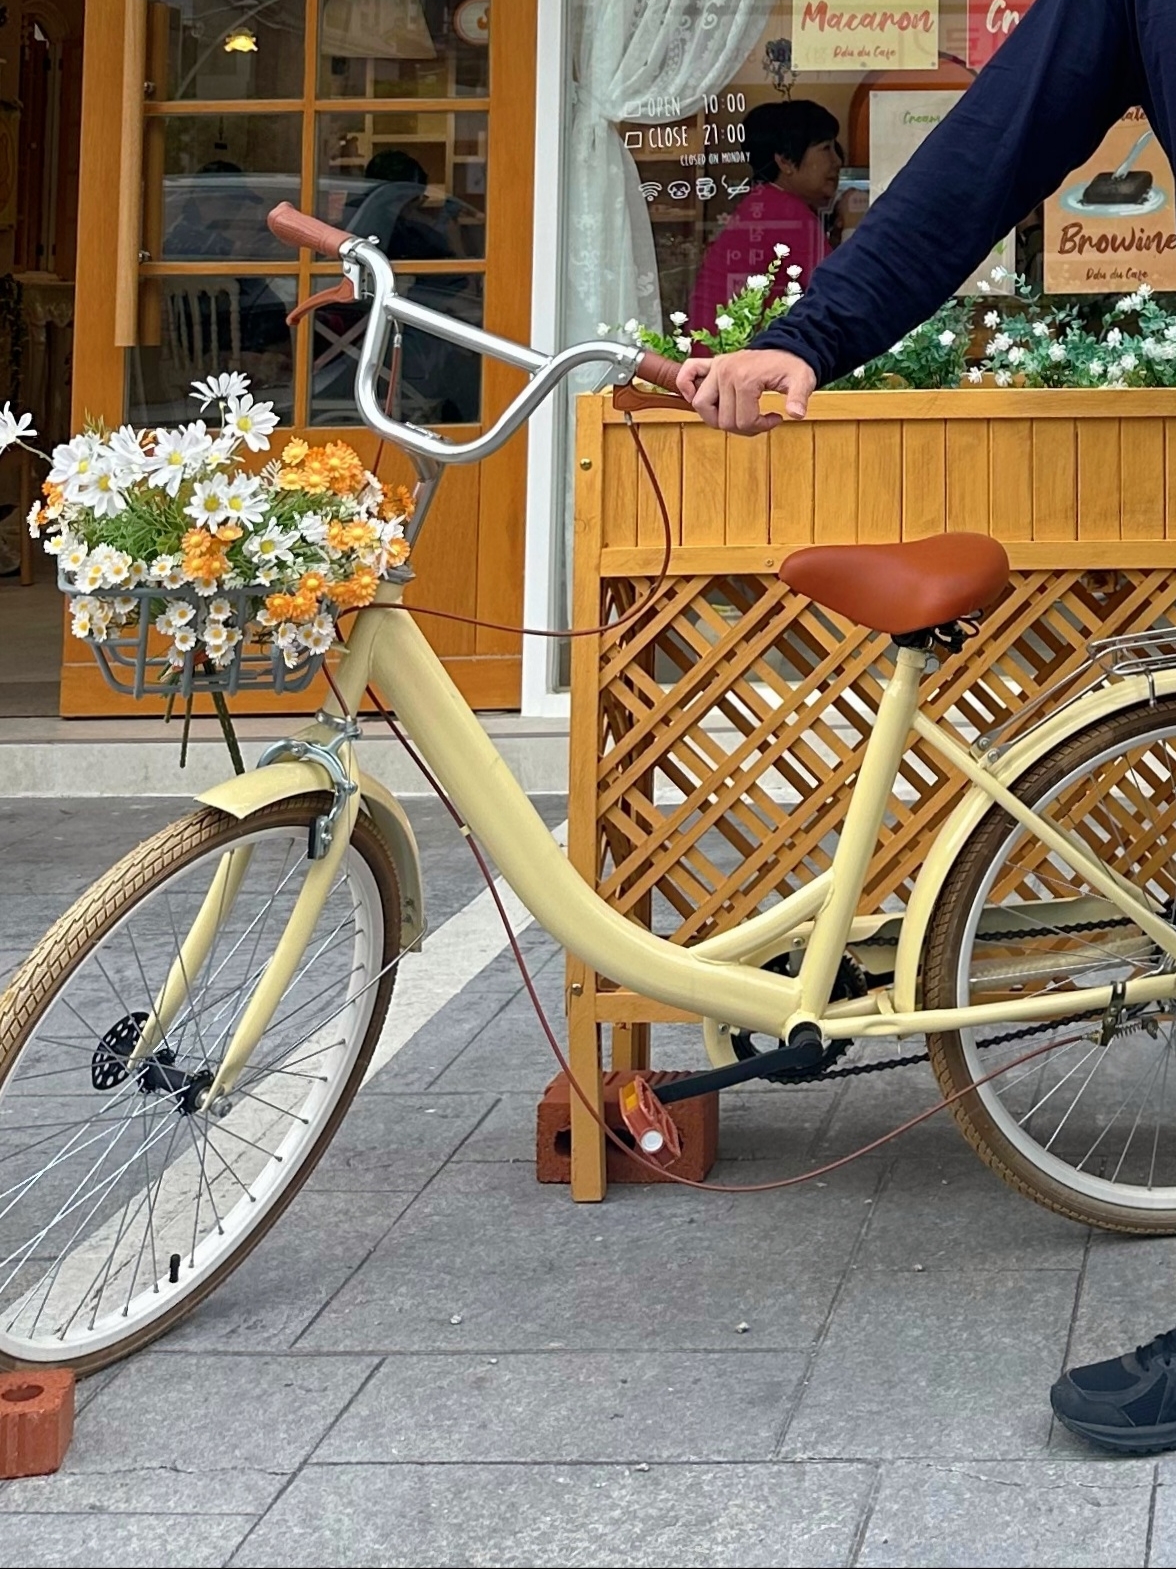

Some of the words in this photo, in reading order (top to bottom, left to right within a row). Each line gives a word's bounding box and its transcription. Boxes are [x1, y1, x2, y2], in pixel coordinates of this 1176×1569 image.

[801, 0, 935, 33] Macaron
[857, 45, 871, 57] du
[873, 45, 897, 61] Cafe
[647, 96, 681, 117] OPEN
[702, 93, 746, 114] 10:00
[648, 126, 689, 148] CLOSE
[703, 123, 746, 145] 21:00
[680, 153, 706, 166] CLOSED
[708, 152, 719, 165] ON
[721, 151, 751, 163] MONDAY
[1109, 267, 1123, 279] du
[1126, 267, 1148, 281] Cafe
